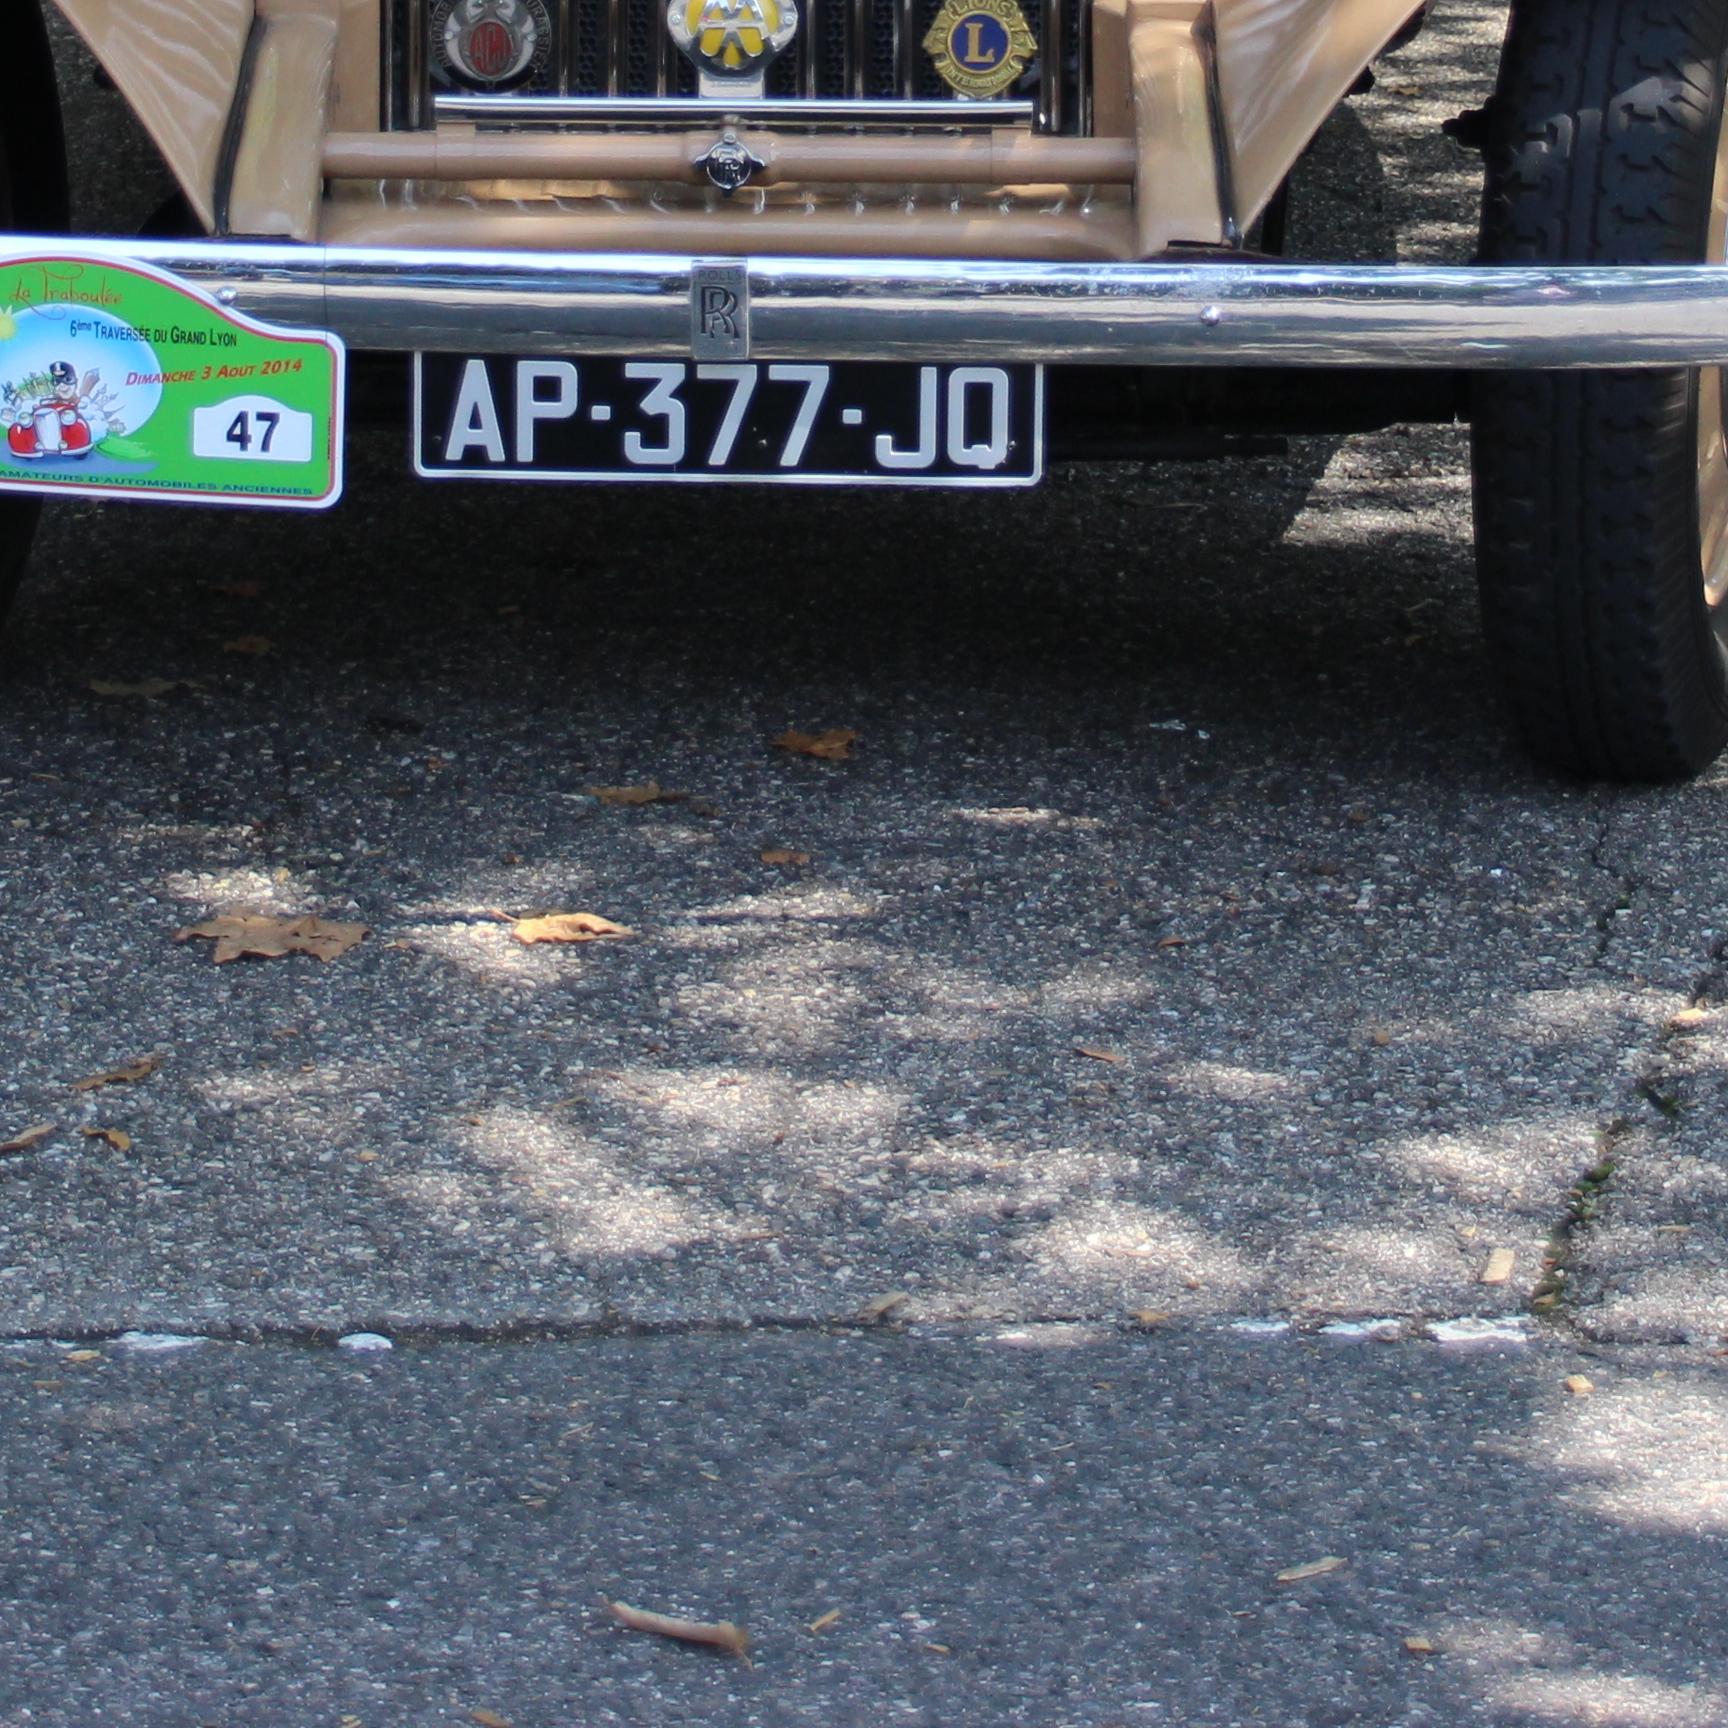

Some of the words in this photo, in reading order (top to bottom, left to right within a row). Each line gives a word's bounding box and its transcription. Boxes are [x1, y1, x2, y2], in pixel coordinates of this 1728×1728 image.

[964, 23, 995, 63] L
[154, 329, 167, 344] DU
[171, 325, 207, 346] GRAND
[209, 327, 237, 347] LYON
[125, 369, 196, 386] DIMANCHE
[200, 365, 212, 381] 3
[216, 363, 257, 379] AOUT
[260, 357, 304, 376] 2014
[226, 410, 281, 453] 47
[88, 475, 218, 491] D'AUTOMOBILES
[222, 483, 314, 497] ANCIENNES
